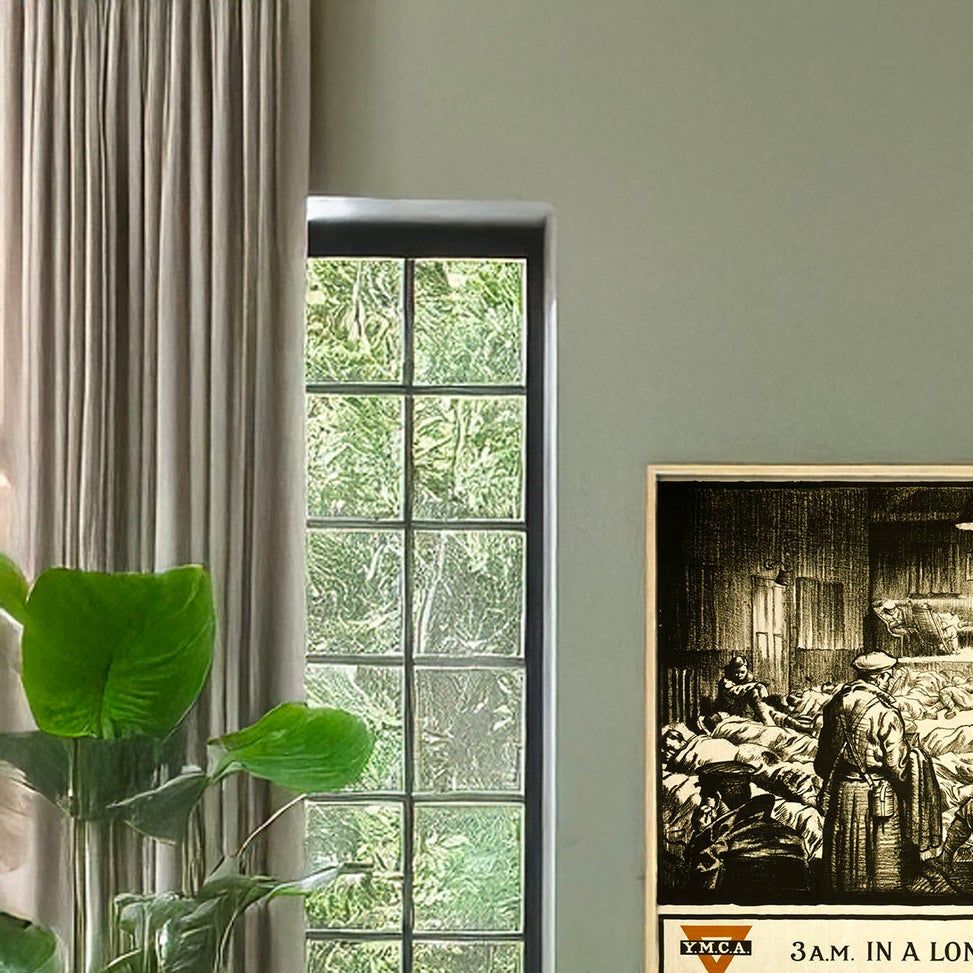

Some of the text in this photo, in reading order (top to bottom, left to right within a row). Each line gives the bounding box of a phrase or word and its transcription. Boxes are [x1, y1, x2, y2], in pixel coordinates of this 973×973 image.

[683, 941, 750, 954] Y.M.C.A.
[866, 941, 892, 962] IN
[901, 941, 921, 962] A
